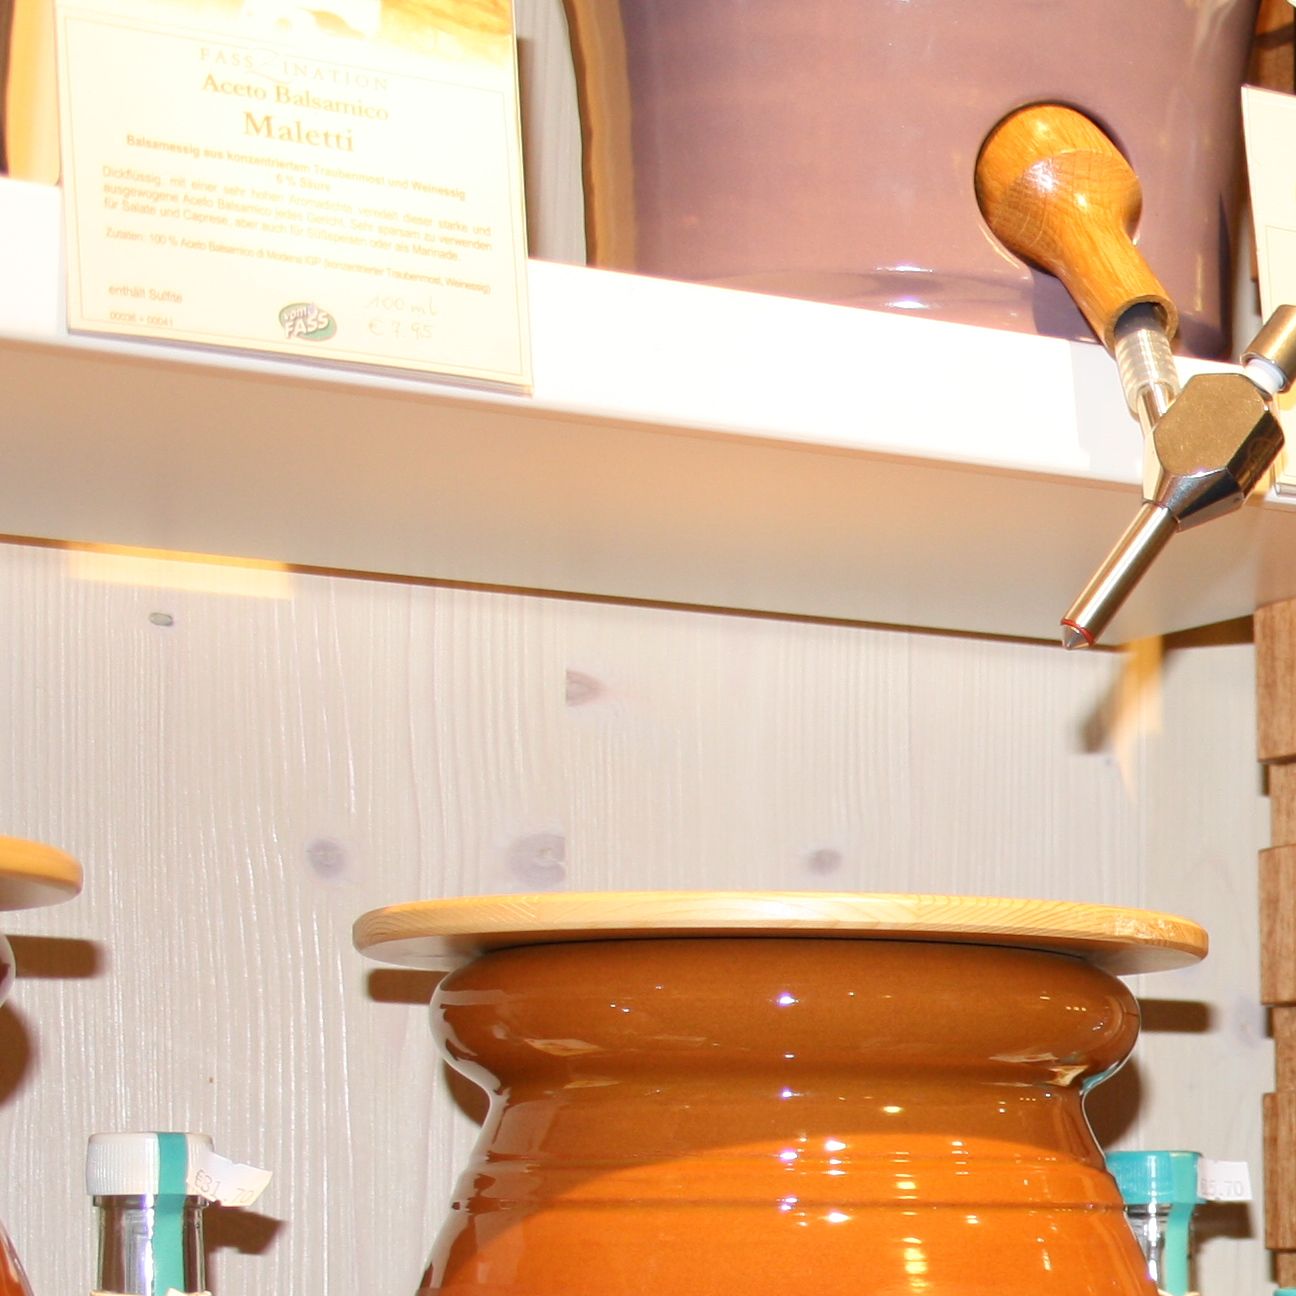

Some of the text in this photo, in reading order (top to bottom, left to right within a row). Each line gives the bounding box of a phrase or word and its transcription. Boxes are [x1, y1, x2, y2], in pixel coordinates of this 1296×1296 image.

[201, 74, 388, 120] Aceto Balsamico
[243, 111, 353, 152] Maletti
[282, 311, 330, 341] FASS
